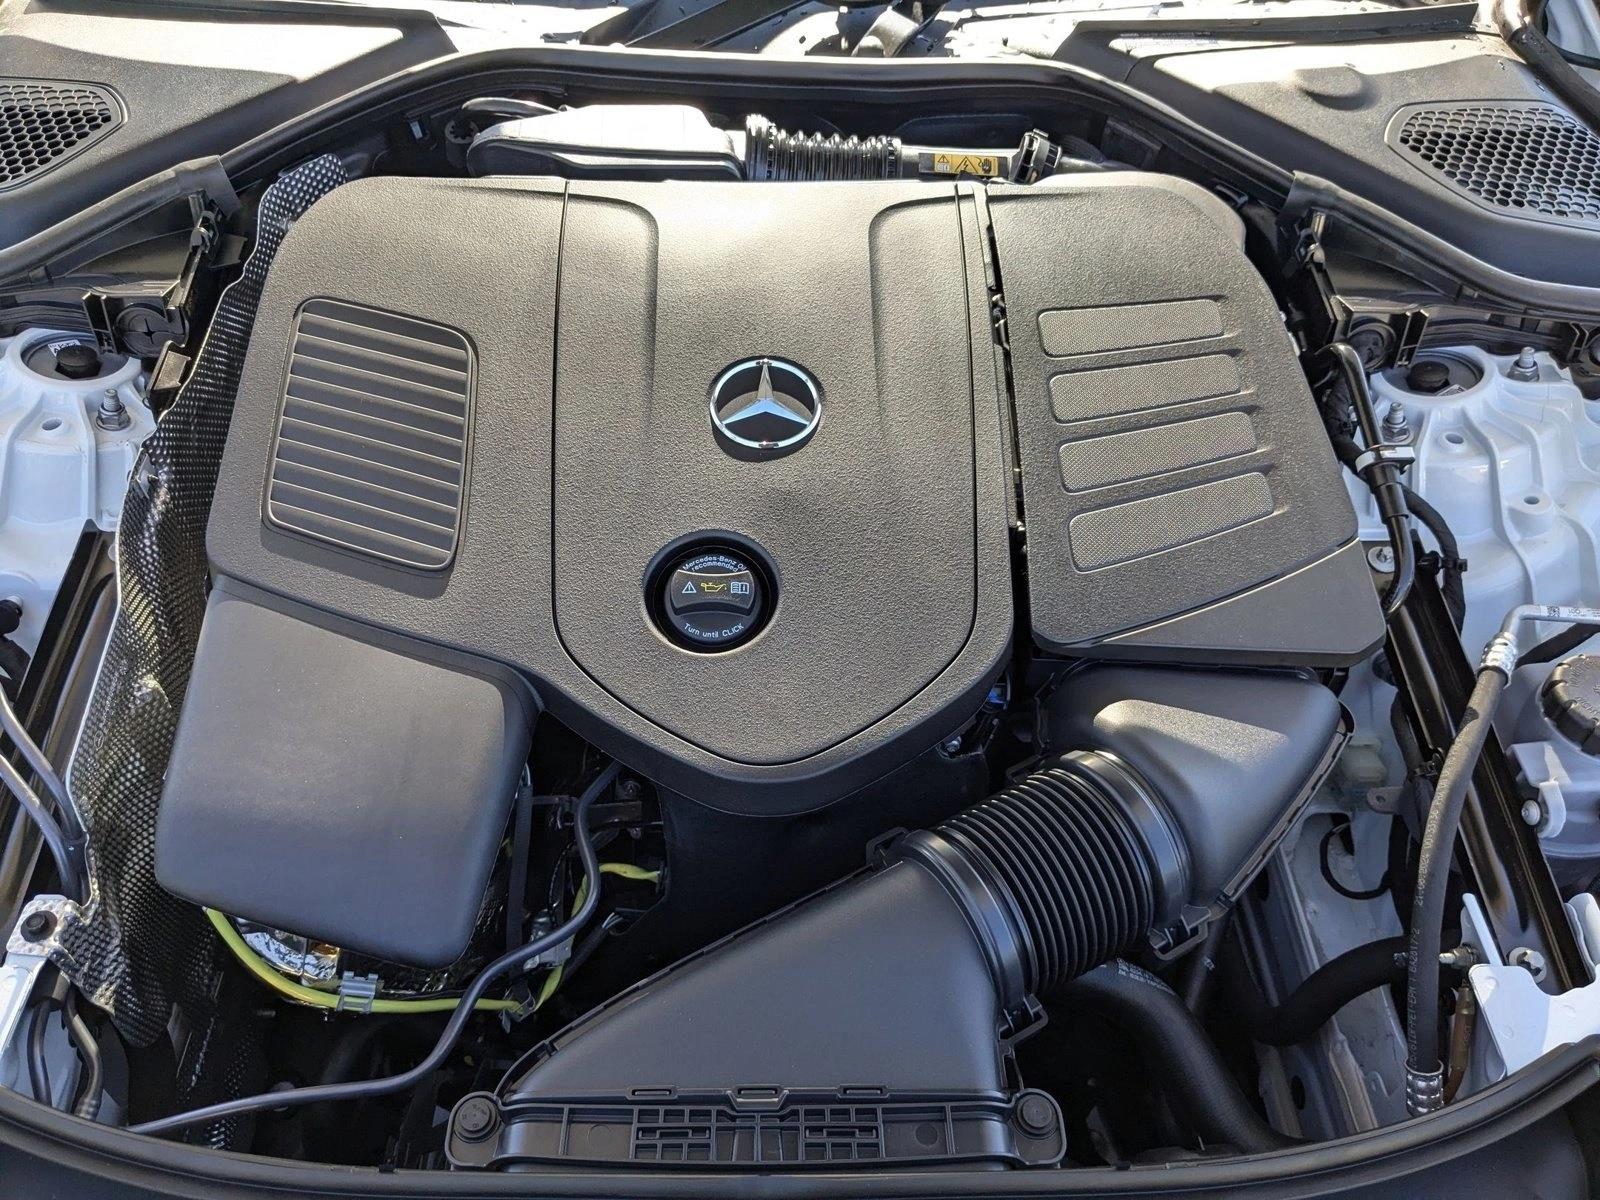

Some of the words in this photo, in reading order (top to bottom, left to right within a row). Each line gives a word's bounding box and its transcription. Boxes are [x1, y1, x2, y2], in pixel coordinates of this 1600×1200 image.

[683, 556, 737, 570] Mercedes-Benz
[692, 561, 738, 572] recommended
[685, 623, 699, 635] Turn
[722, 623, 744, 636] CLICK
